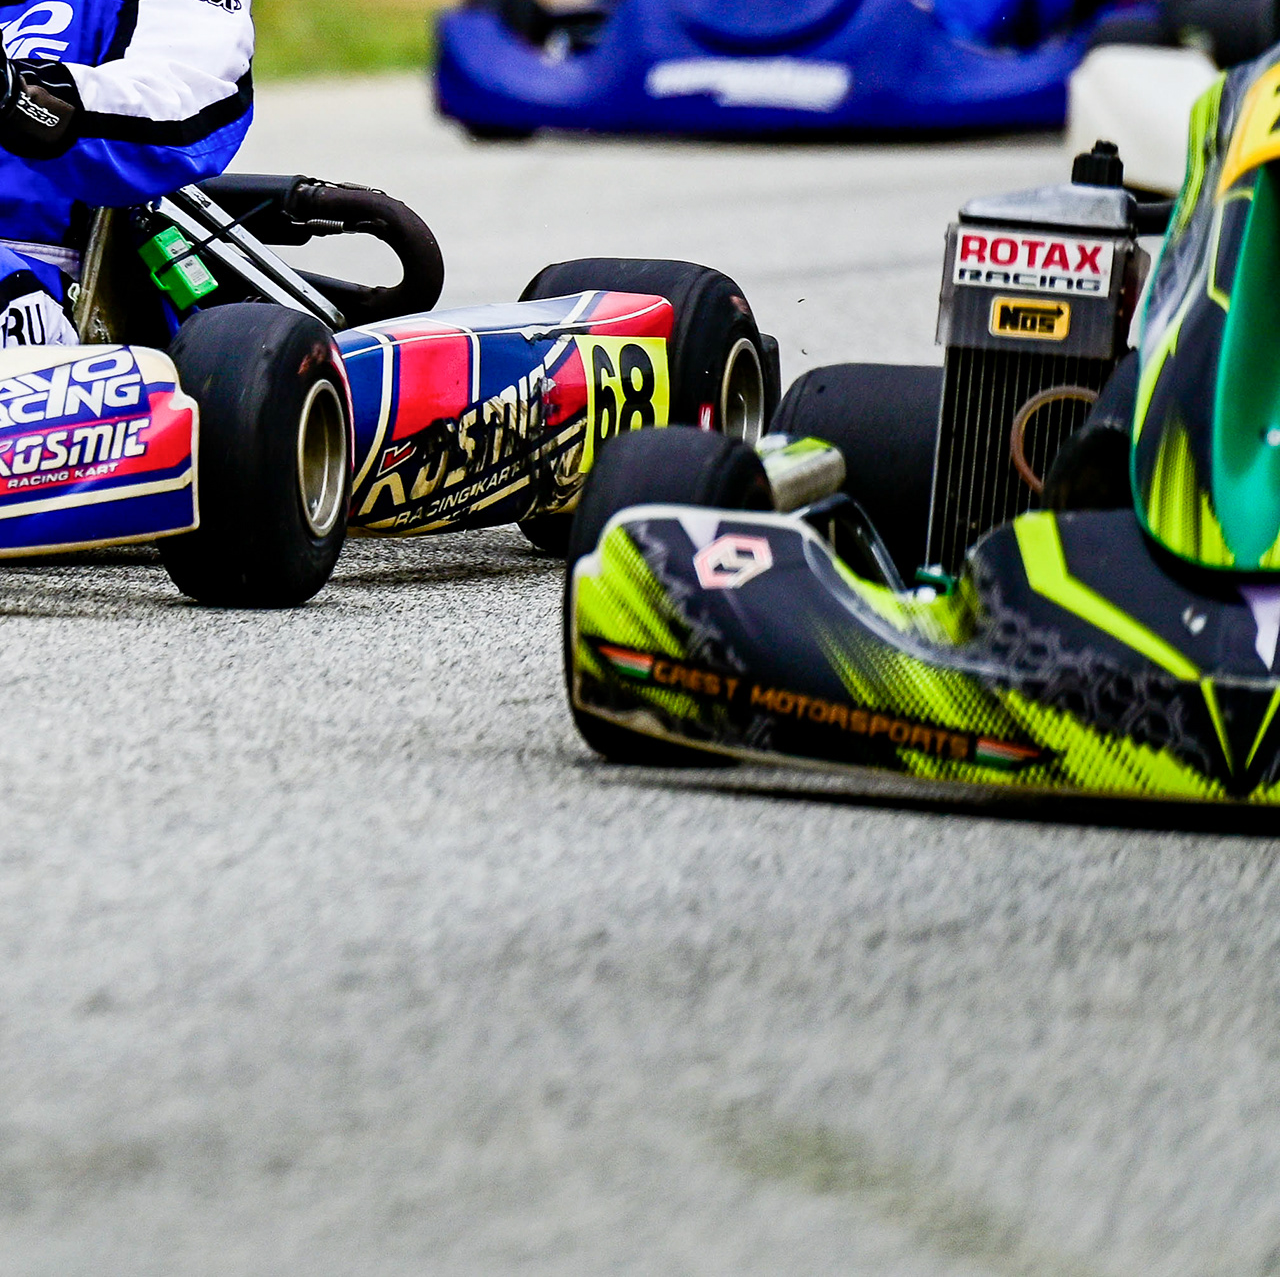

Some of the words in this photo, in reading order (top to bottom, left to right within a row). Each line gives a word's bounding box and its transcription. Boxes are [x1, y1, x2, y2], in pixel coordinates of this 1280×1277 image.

[960, 235, 1103, 275] ROTAX
[958, 267, 1102, 292] RACING
[592, 343, 655, 449] 68
[6, 472, 69, 489] RACING
[74, 462, 118, 478] KART
[652, 659, 739, 702] CREST
[749, 683, 971, 760] MOTORSPORTS
